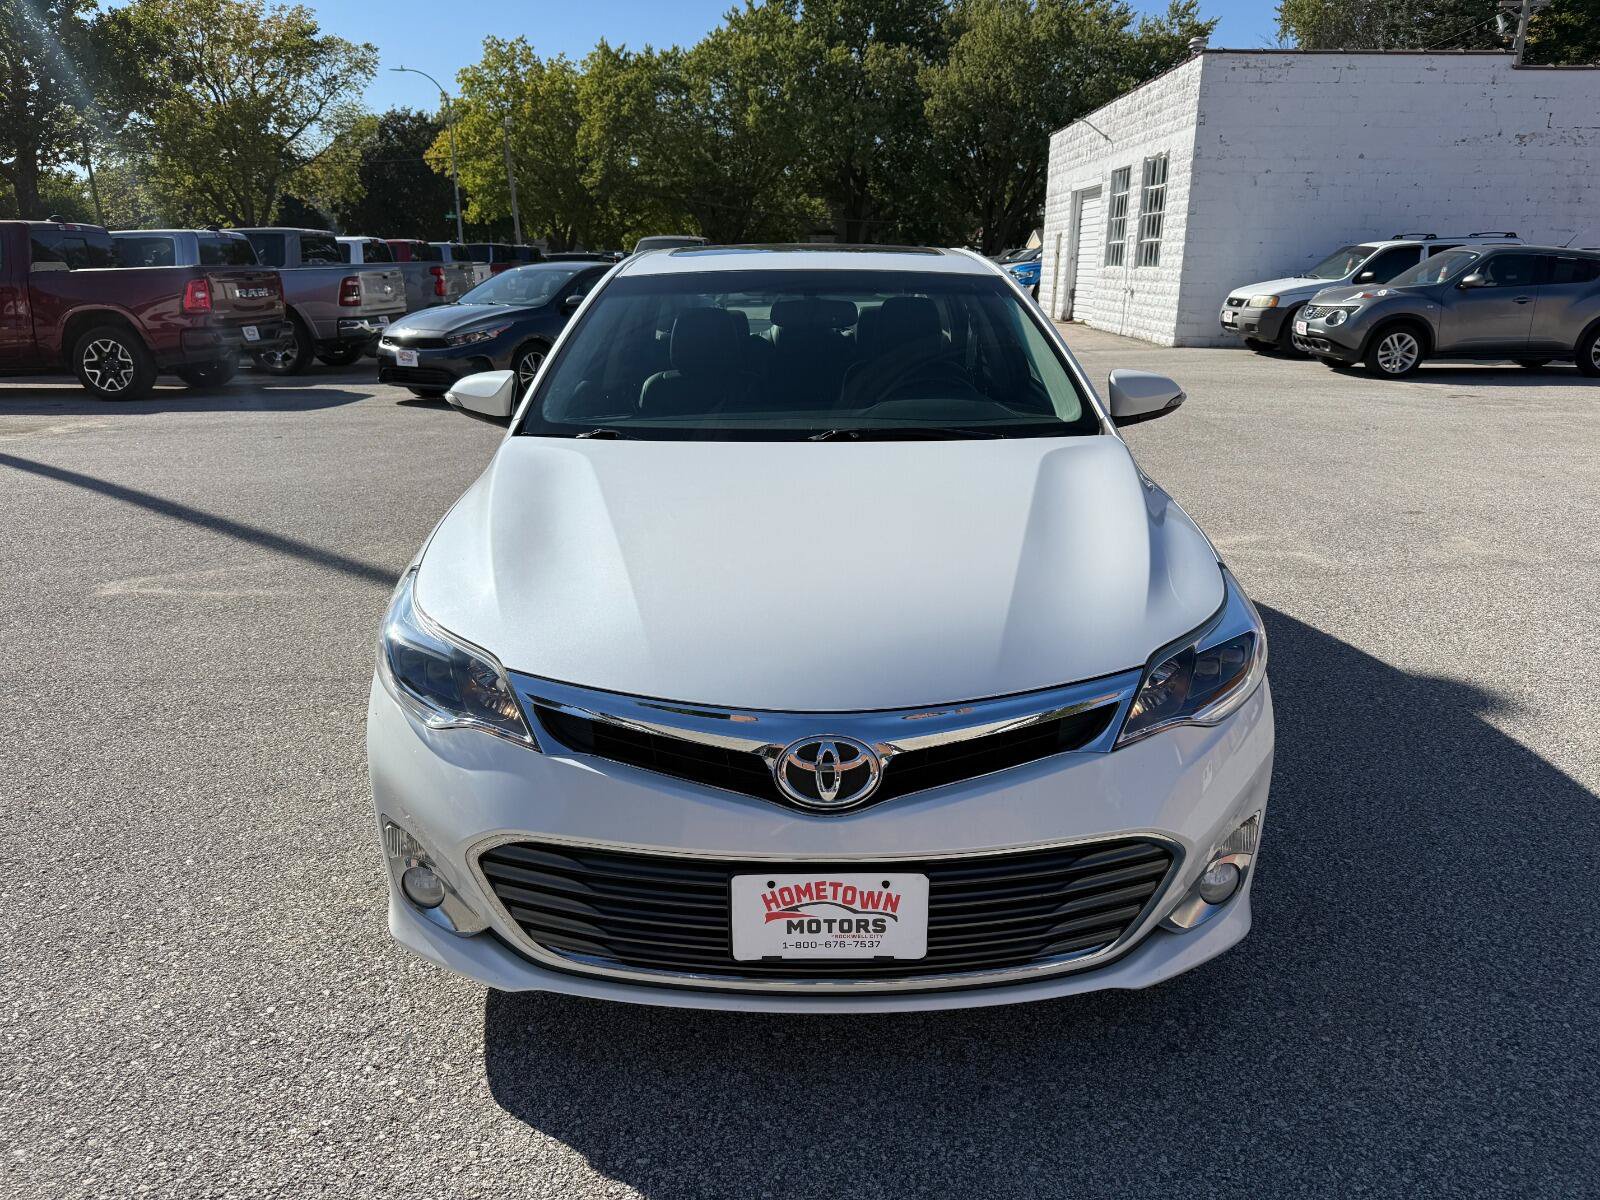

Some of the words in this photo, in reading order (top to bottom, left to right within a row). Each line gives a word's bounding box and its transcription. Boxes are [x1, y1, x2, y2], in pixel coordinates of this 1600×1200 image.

[235, 288, 269, 298] RAM
[761, 881, 902, 913] HOMETOWN
[786, 918, 887, 934] MOTORS
[782, 940, 881, 949] 1-800-676-7537
